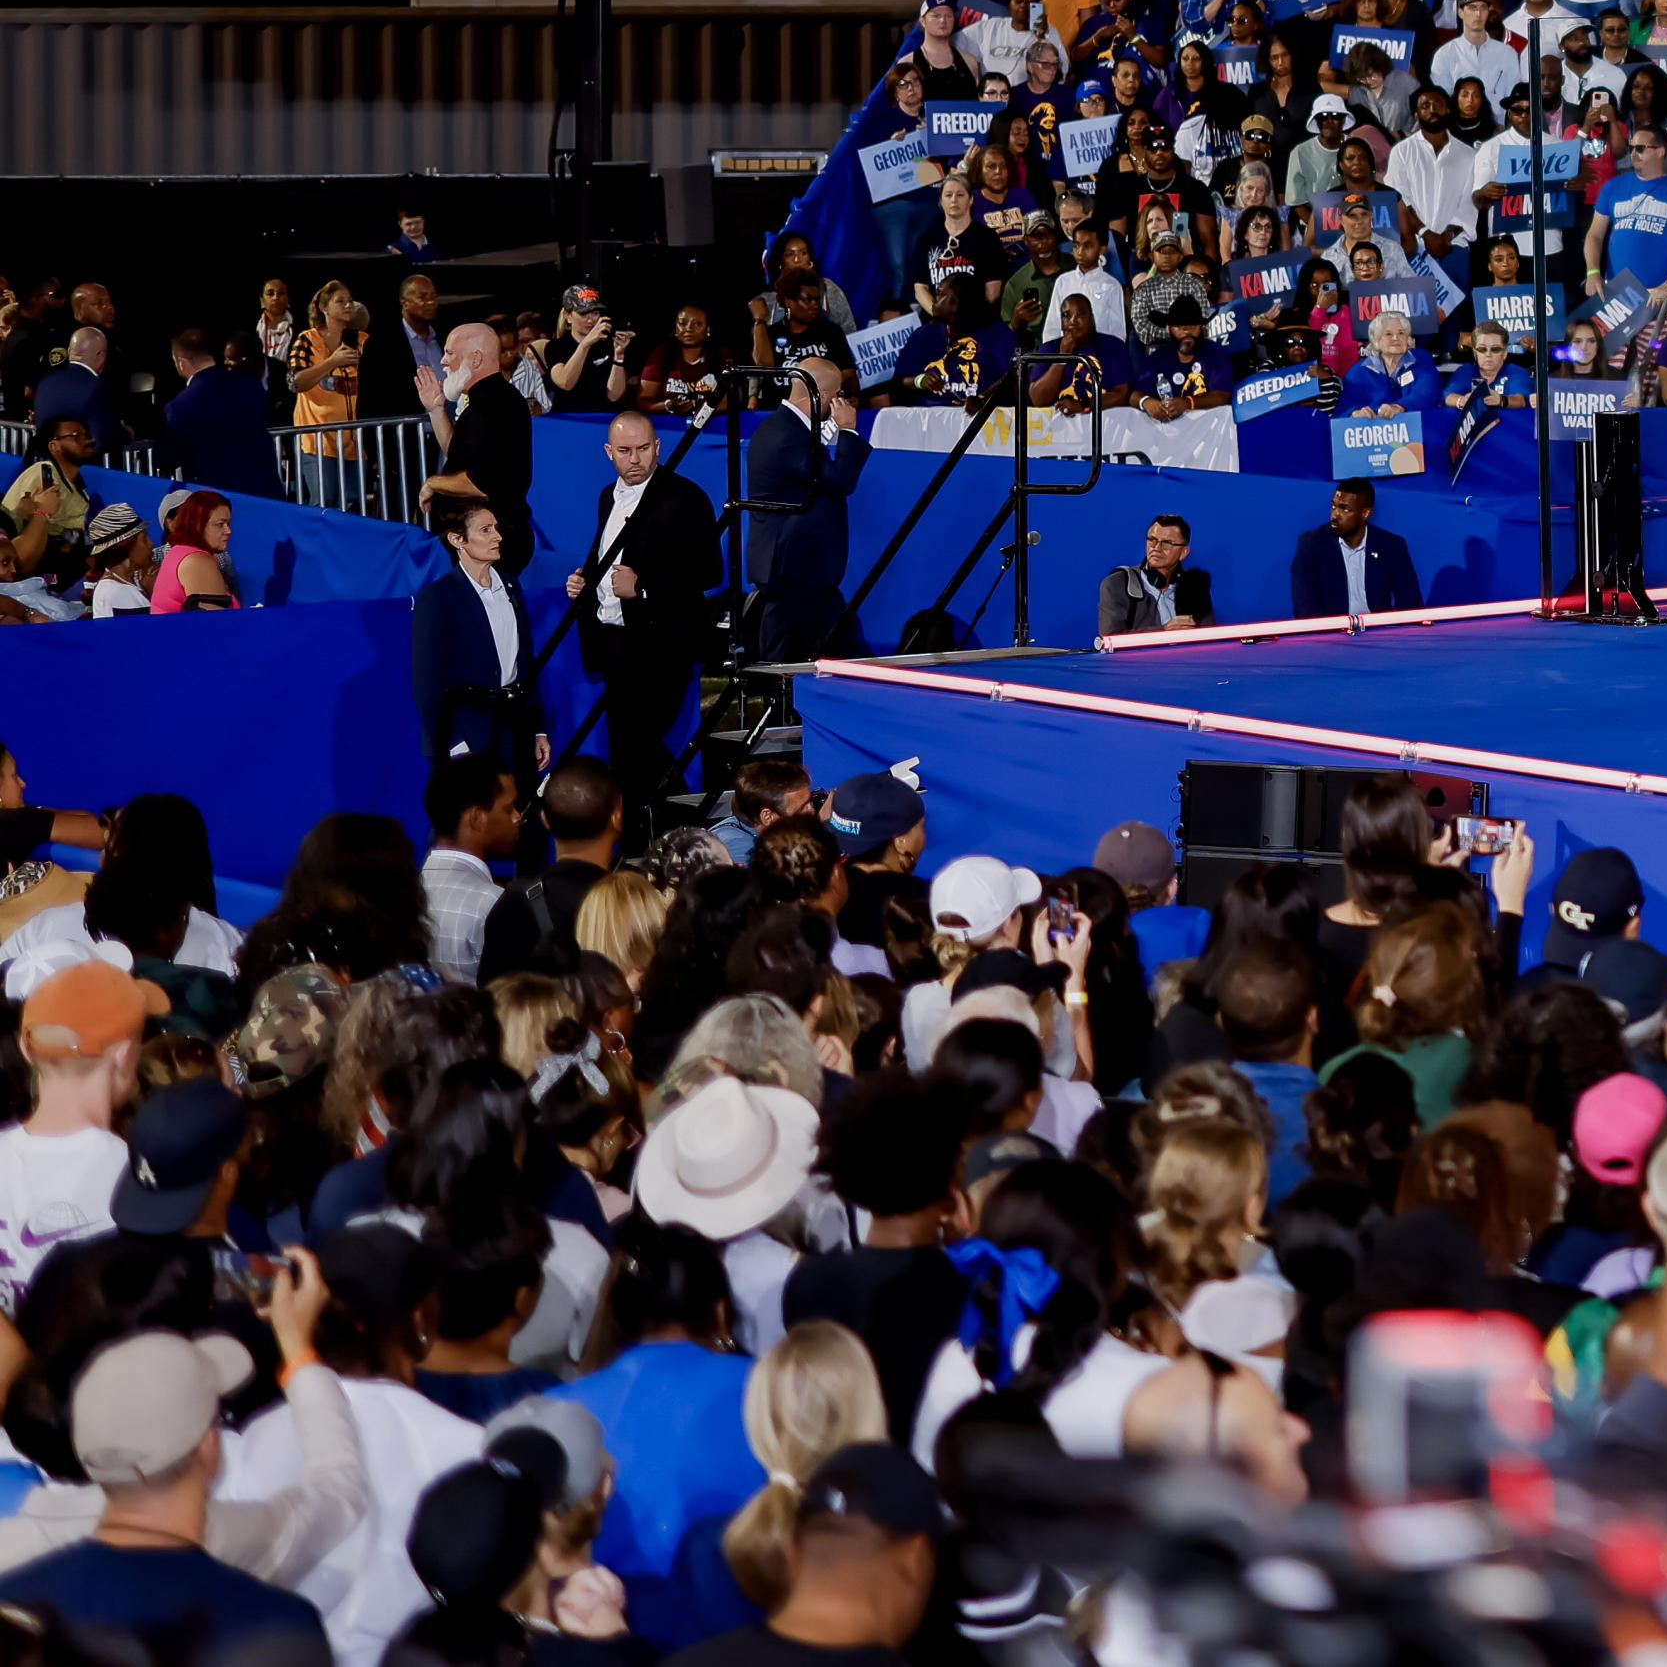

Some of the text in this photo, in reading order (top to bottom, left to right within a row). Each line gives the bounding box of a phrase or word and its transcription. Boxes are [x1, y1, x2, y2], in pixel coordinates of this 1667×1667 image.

[932, 111, 994, 134] FREEDO
[873, 138, 927, 172] GEORGIA
[1635, 220, 1665, 235] HOUSE
[1358, 294, 1428, 320] KAMALA
[1487, 295, 1554, 317] HARRS
[1497, 317, 1535, 332] WAL
[857, 338, 888, 359] NEW
[1237, 372, 1311, 405] FREEDOM
[1554, 392, 1616, 413] HARRIS
[1562, 414, 1595, 429] WAL
[1344, 424, 1409, 448] GEORGIA
